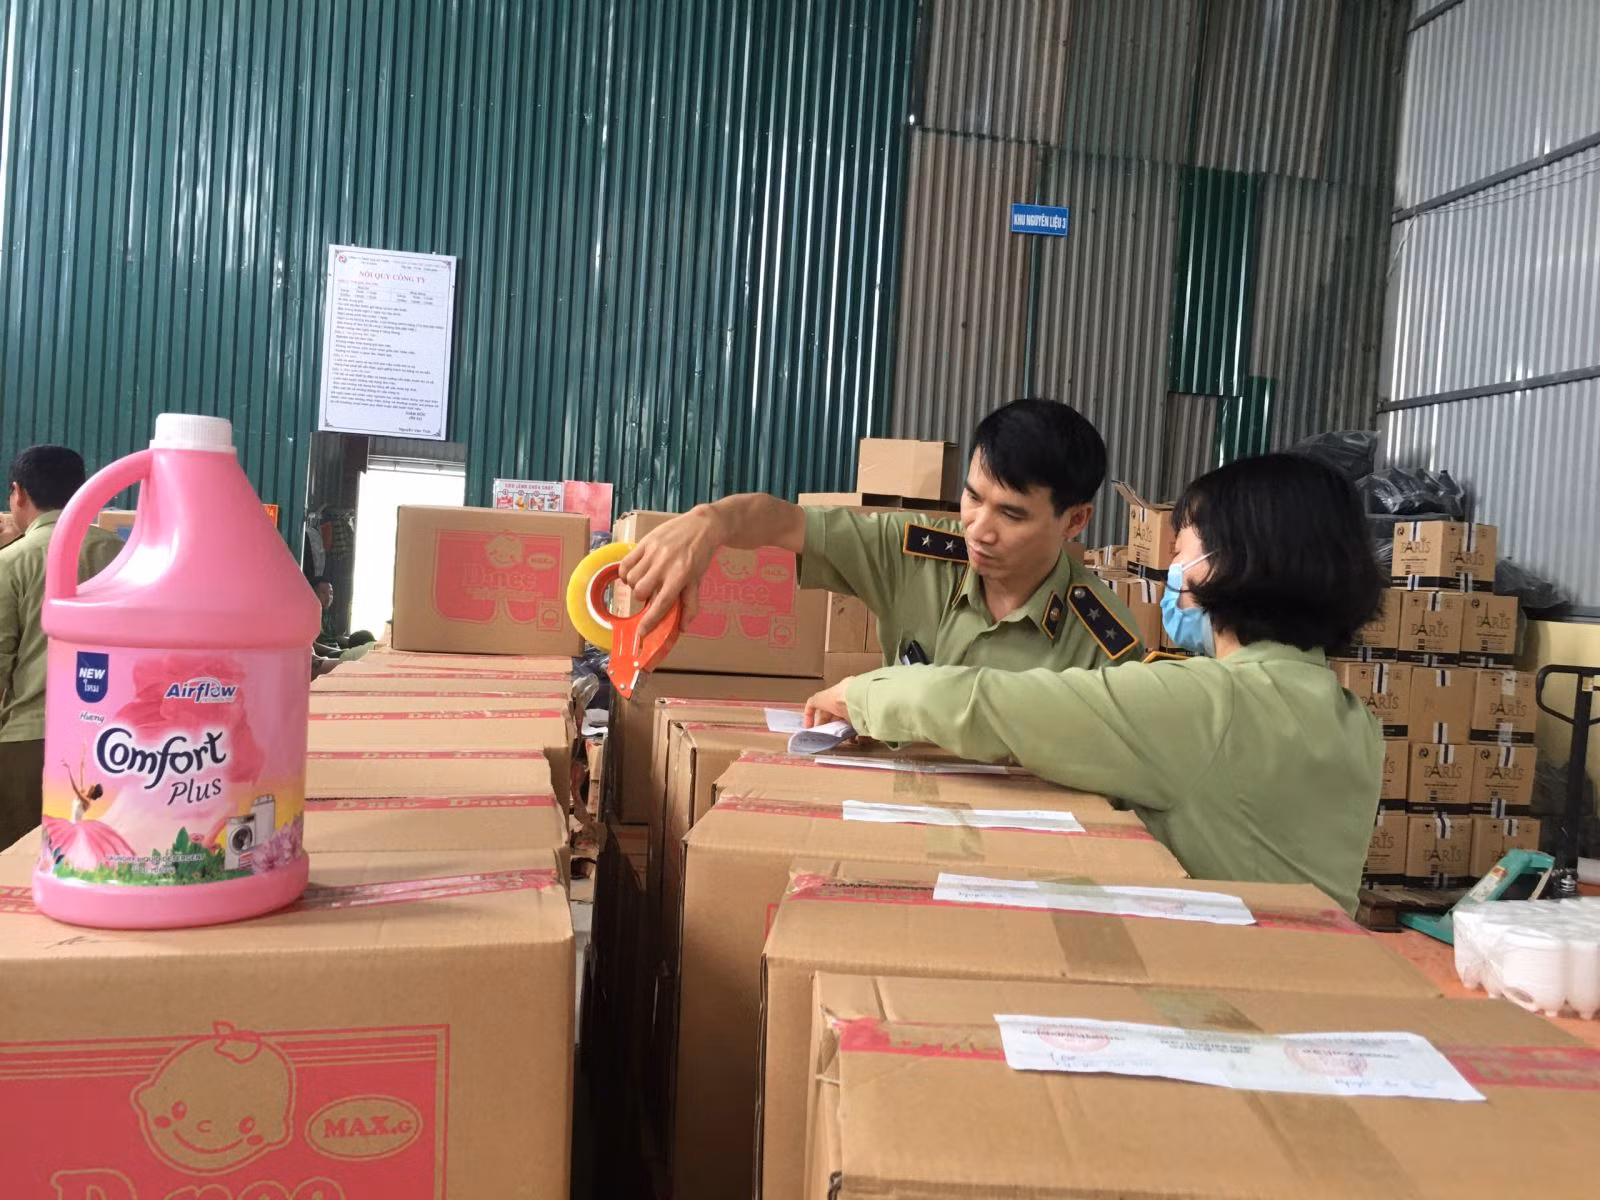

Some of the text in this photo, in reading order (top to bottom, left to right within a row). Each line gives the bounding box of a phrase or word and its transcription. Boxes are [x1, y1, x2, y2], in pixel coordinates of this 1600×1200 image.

[1400, 539, 1431, 554] PARIS
[1450, 546, 1485, 565] PARIS
[1410, 617, 1449, 638] PARIS
[1476, 609, 1511, 629] PARIS
[79, 667, 106, 680] NEW
[166, 682, 237, 702] Airflow
[1361, 692, 1399, 710] PARIS
[1489, 699, 1528, 717] PARIS
[96, 727, 227, 790] Comfort
[1424, 759, 1463, 779] PARIS
[1485, 761, 1525, 781] PARIS
[167, 777, 222, 806] Plus
[322, 1114, 413, 1140] MAX.G
